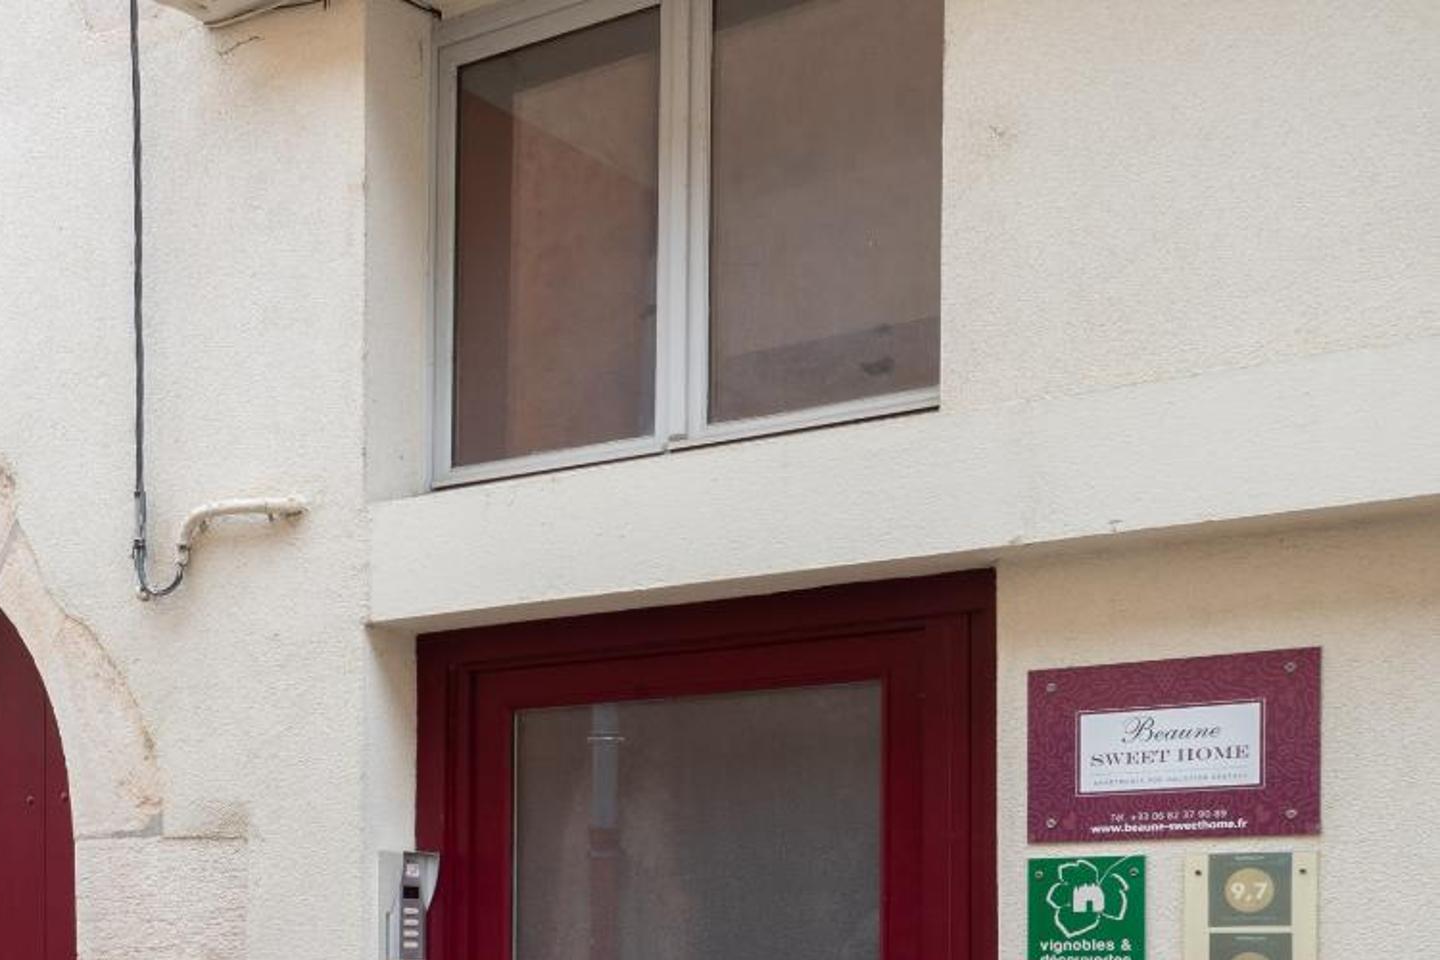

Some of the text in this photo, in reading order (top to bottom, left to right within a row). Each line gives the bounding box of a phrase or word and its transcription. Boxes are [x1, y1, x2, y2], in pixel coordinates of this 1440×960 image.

[1121, 716, 1222, 744] Beaune
[1089, 744, 1250, 768] SWEET HOME
[1090, 817, 1249, 834] www.beaune-sweethome.fr
[1040, 938, 1132, 954] vignobles &
